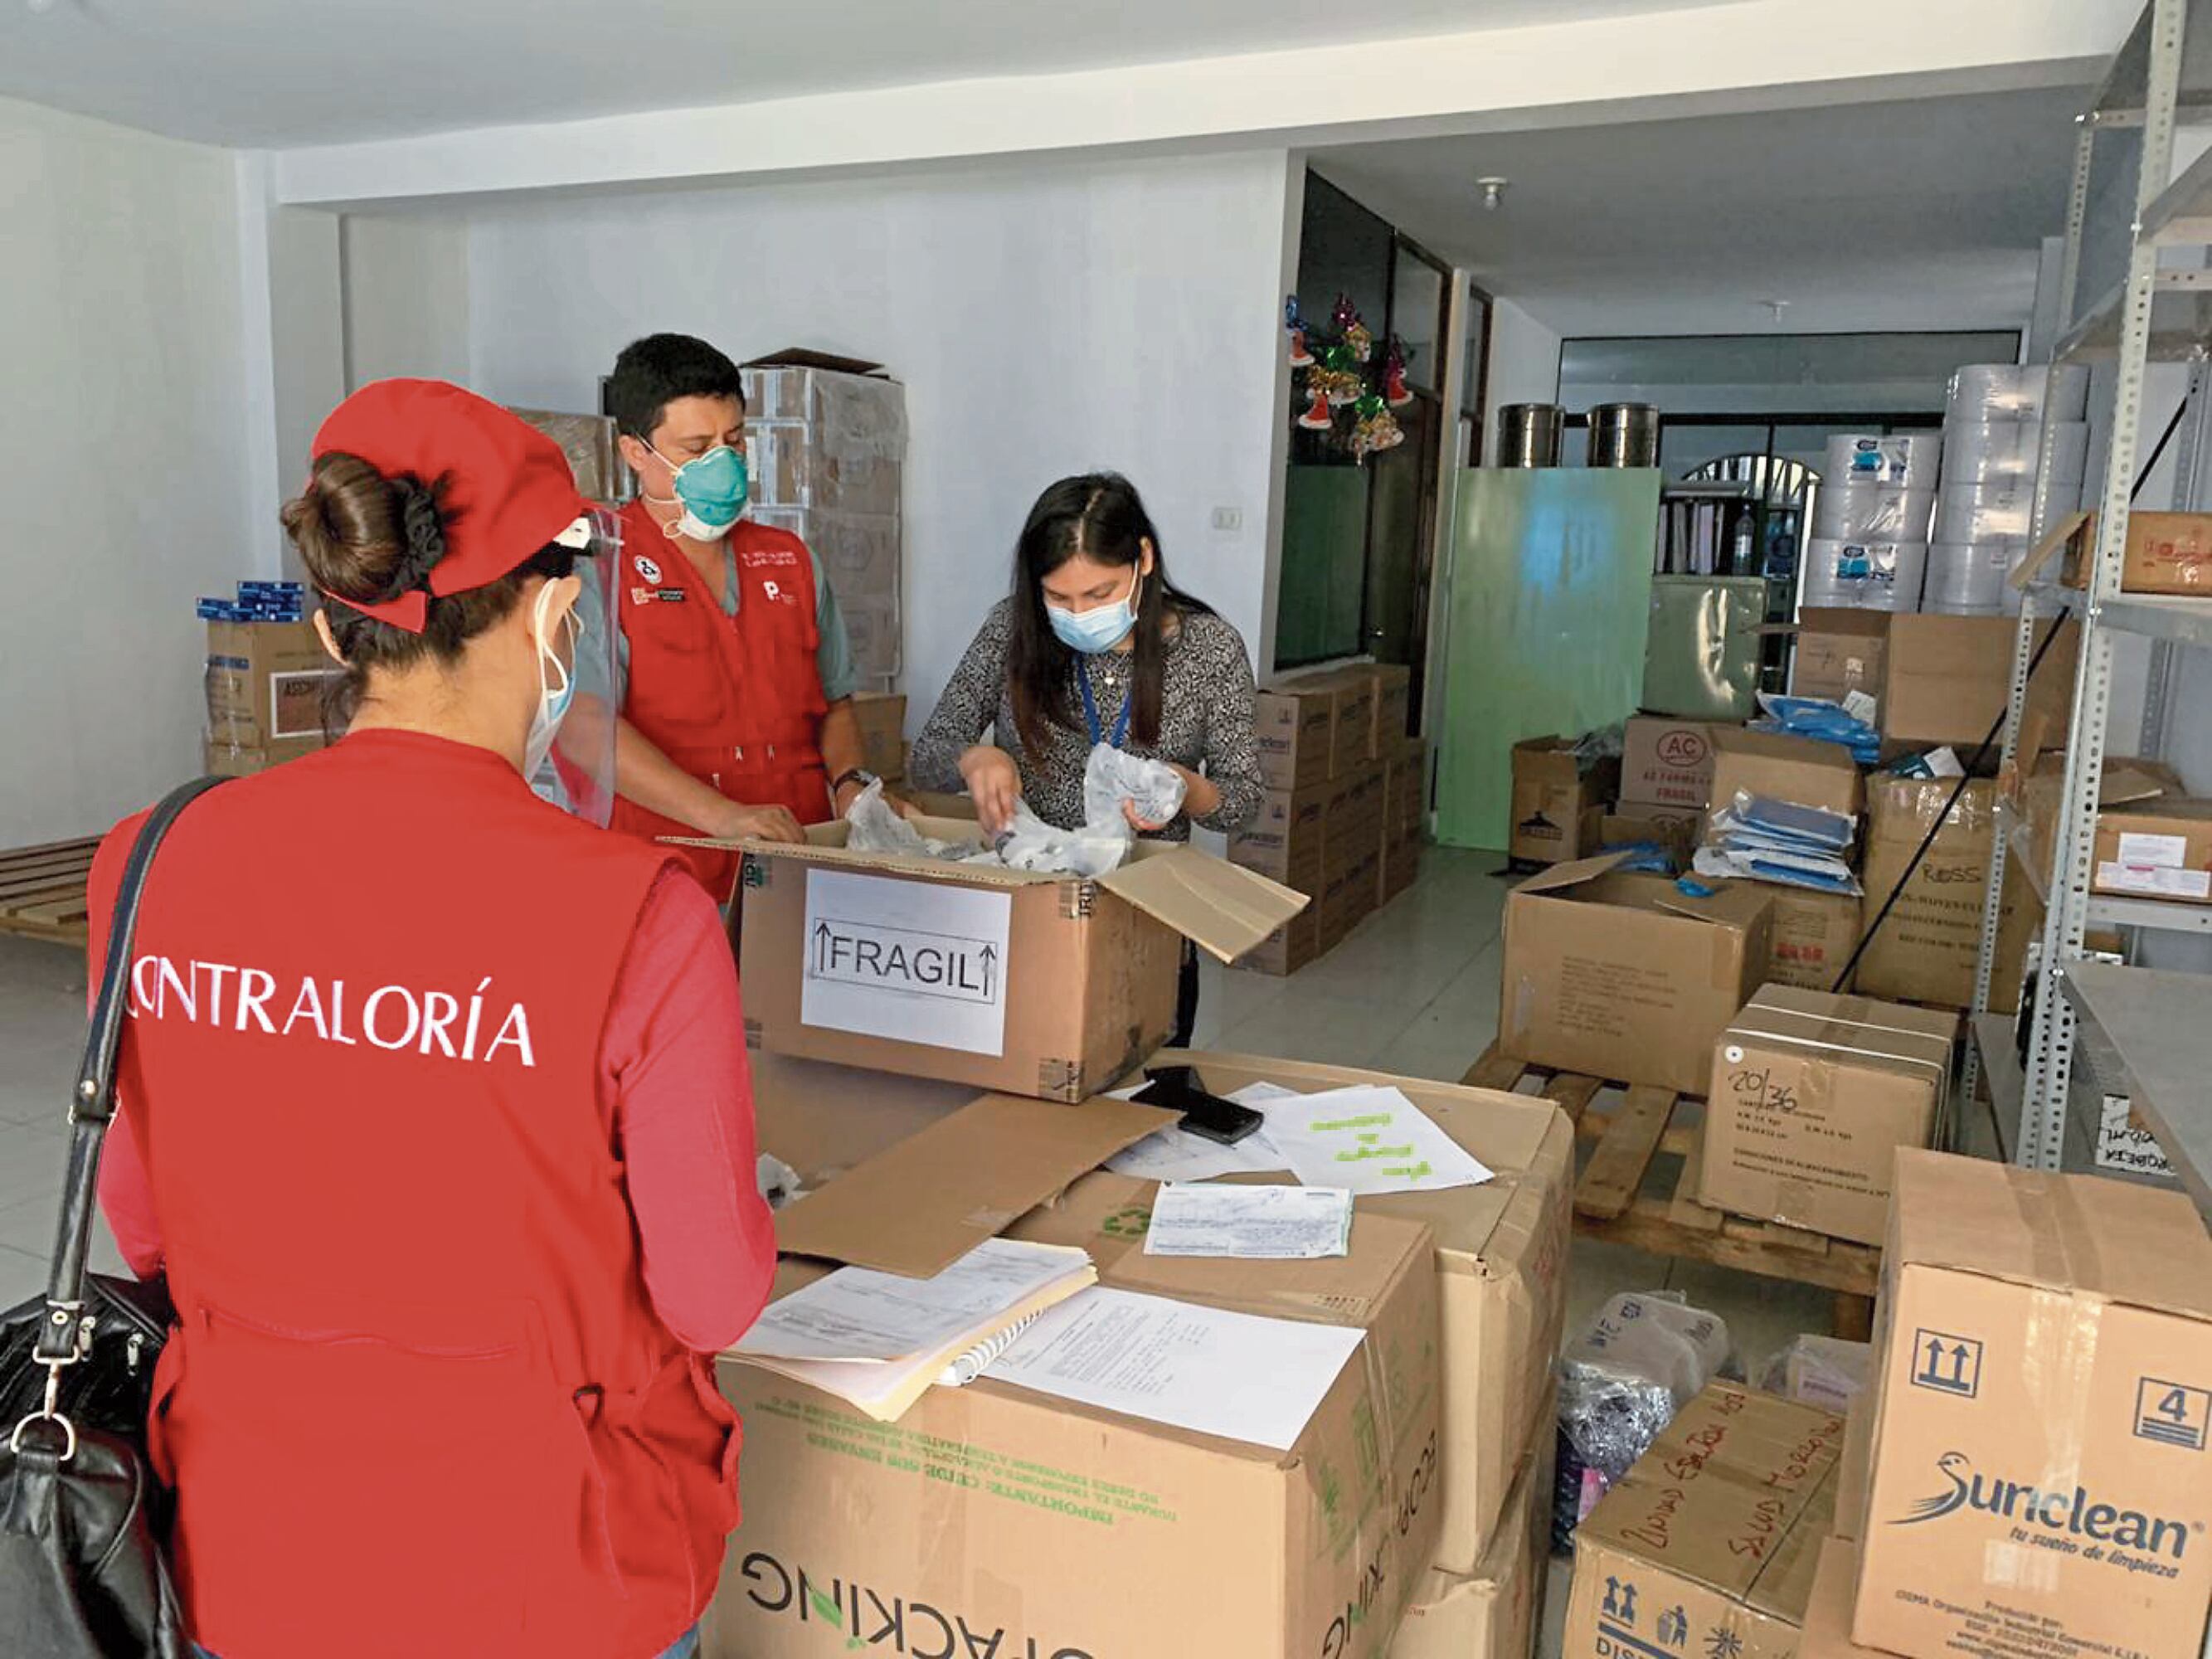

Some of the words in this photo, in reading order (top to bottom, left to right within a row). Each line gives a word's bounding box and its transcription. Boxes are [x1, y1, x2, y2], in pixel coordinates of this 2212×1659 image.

[1666, 737, 1697, 756] AC
[830, 936, 980, 992] FRAGIL
[128, 954, 536, 1067] ONTRALORÍA
[2158, 1389, 2187, 1421] 4
[1885, 1451, 2188, 1559] Sunclean
[2010, 1525, 2027, 1544] tu
[2030, 1530, 2077, 1555] sueño
[2083, 1542, 2103, 1561] de
[2107, 1547, 2180, 1579] limpieza
[1596, 1636, 1644, 1659] DIS
